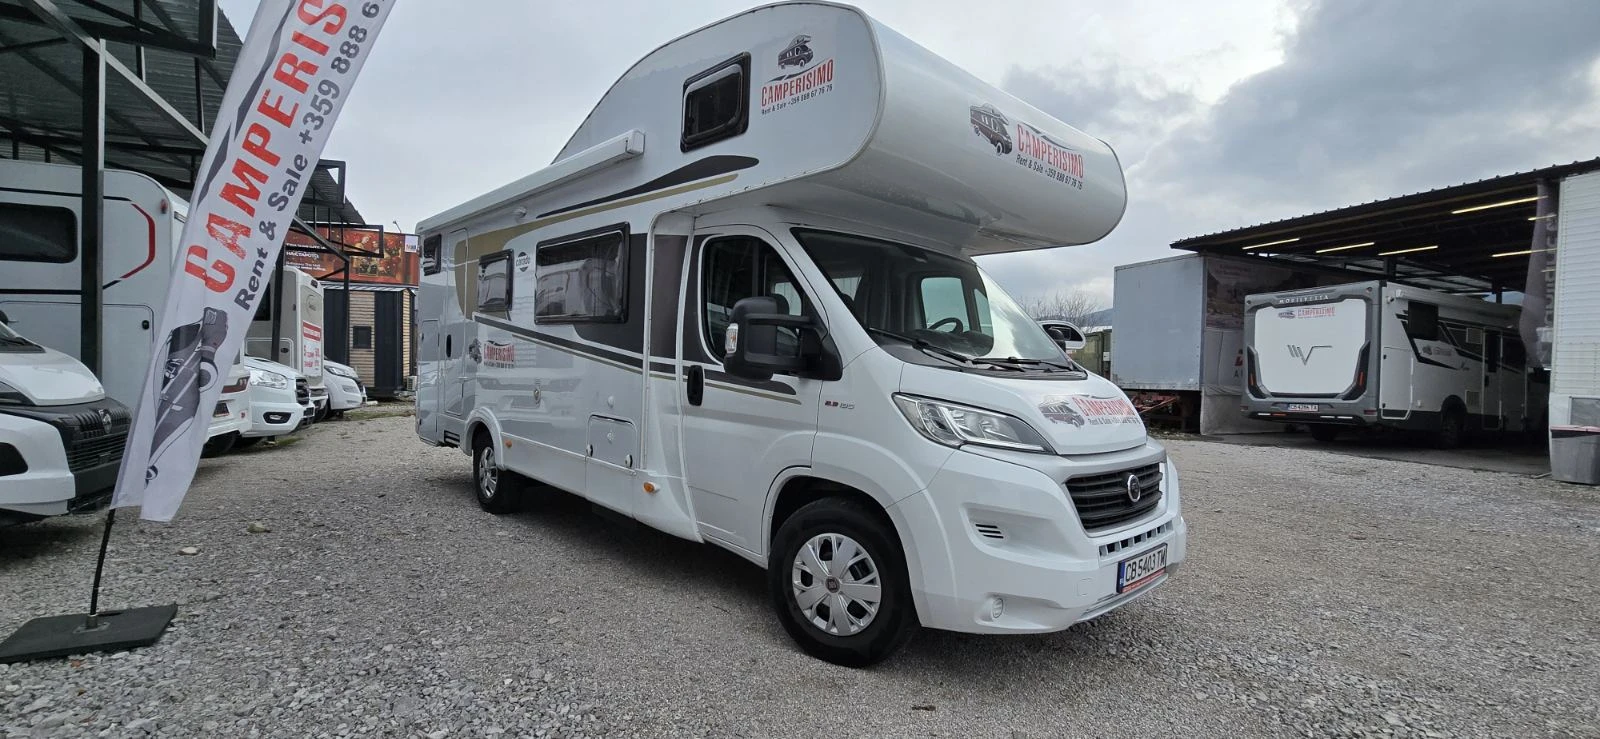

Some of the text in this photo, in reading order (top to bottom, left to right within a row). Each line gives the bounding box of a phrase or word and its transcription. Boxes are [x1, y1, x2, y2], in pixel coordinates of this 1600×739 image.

[361, 0, 384, 19] 6
[330, 25, 368, 75] 888
[761, 59, 834, 107] CAMPERISIMO
[298, 79, 340, 145] +359
[1016, 123, 1084, 179] CAMPERISIMO
[267, 153, 308, 212] Sale
[259, 220, 277, 241] &
[233, 247, 268, 311] Rent
[1125, 561, 1137, 582] CB
[1138, 554, 1156, 577] 5403
